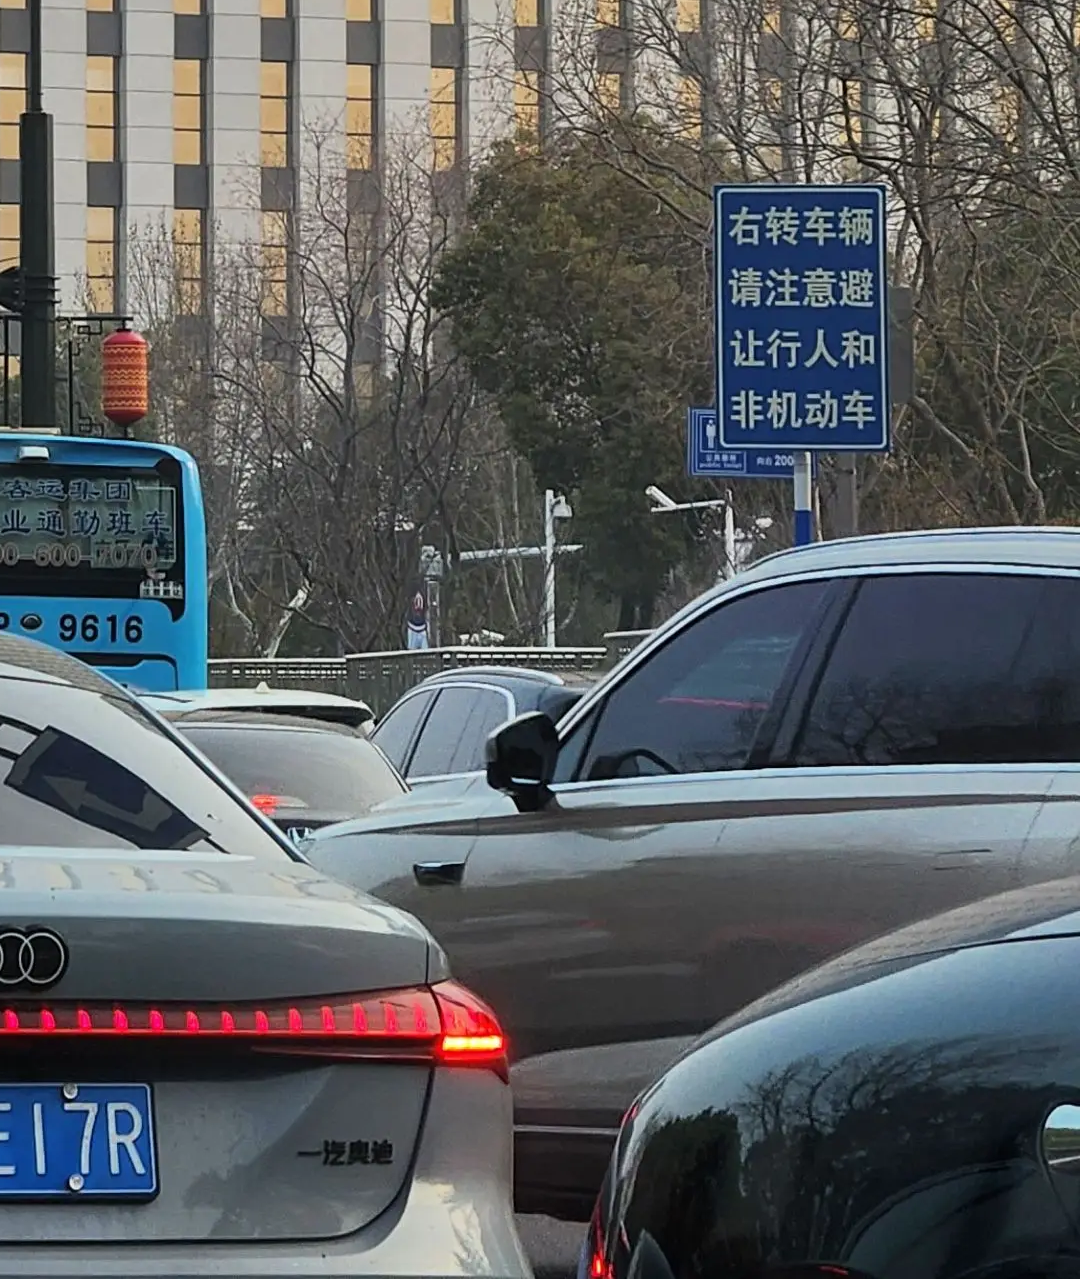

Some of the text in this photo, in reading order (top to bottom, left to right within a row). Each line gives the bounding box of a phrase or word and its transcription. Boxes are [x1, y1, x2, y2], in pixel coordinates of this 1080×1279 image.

[728, 206, 875, 246] 右转车辆
[728, 268, 875, 308] 请注意避
[729, 329, 876, 369] 让行人和
[730, 390, 877, 429] 非机动车
[58, 613, 144, 643] 9616
